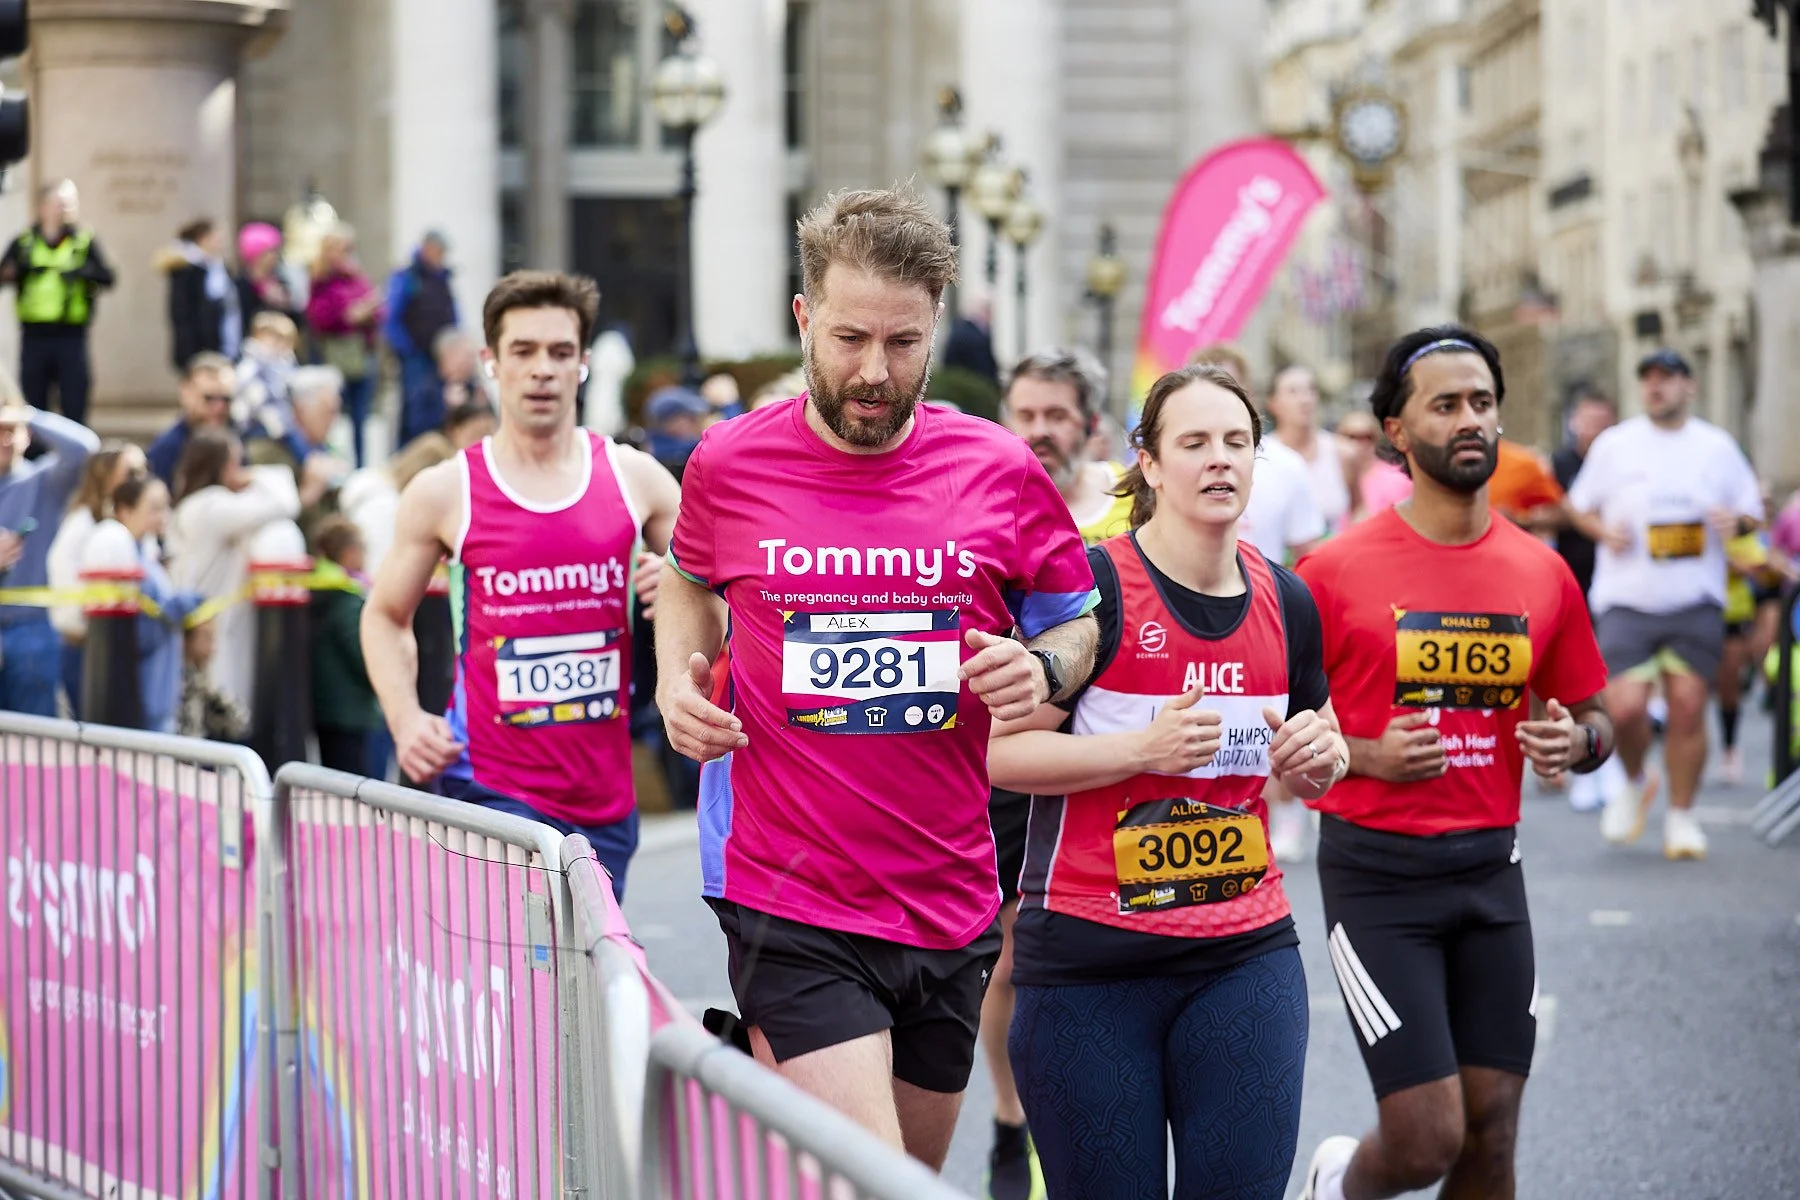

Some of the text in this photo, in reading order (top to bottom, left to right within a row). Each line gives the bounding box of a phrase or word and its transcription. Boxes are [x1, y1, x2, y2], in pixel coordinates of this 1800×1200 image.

[758, 538, 977, 587] Tommy's
[476, 556, 625, 597] Tommy's
[760, 590, 973, 606] The pregnancy and baby charity
[827, 617, 870, 629] ALEX
[1441, 616, 1490, 629] KHALED
[810, 646, 927, 689] 9281
[1418, 640, 1510, 675] 3163
[509, 656, 611, 694] 10387
[1182, 662, 1244, 693] ALICE
[1228, 728, 1274, 746] HAMPSO
[1211, 749, 1261, 768] NDATION
[1446, 751, 1495, 768] ndation
[1170, 803, 1208, 817] ALICE
[1138, 826, 1245, 872] 3092
